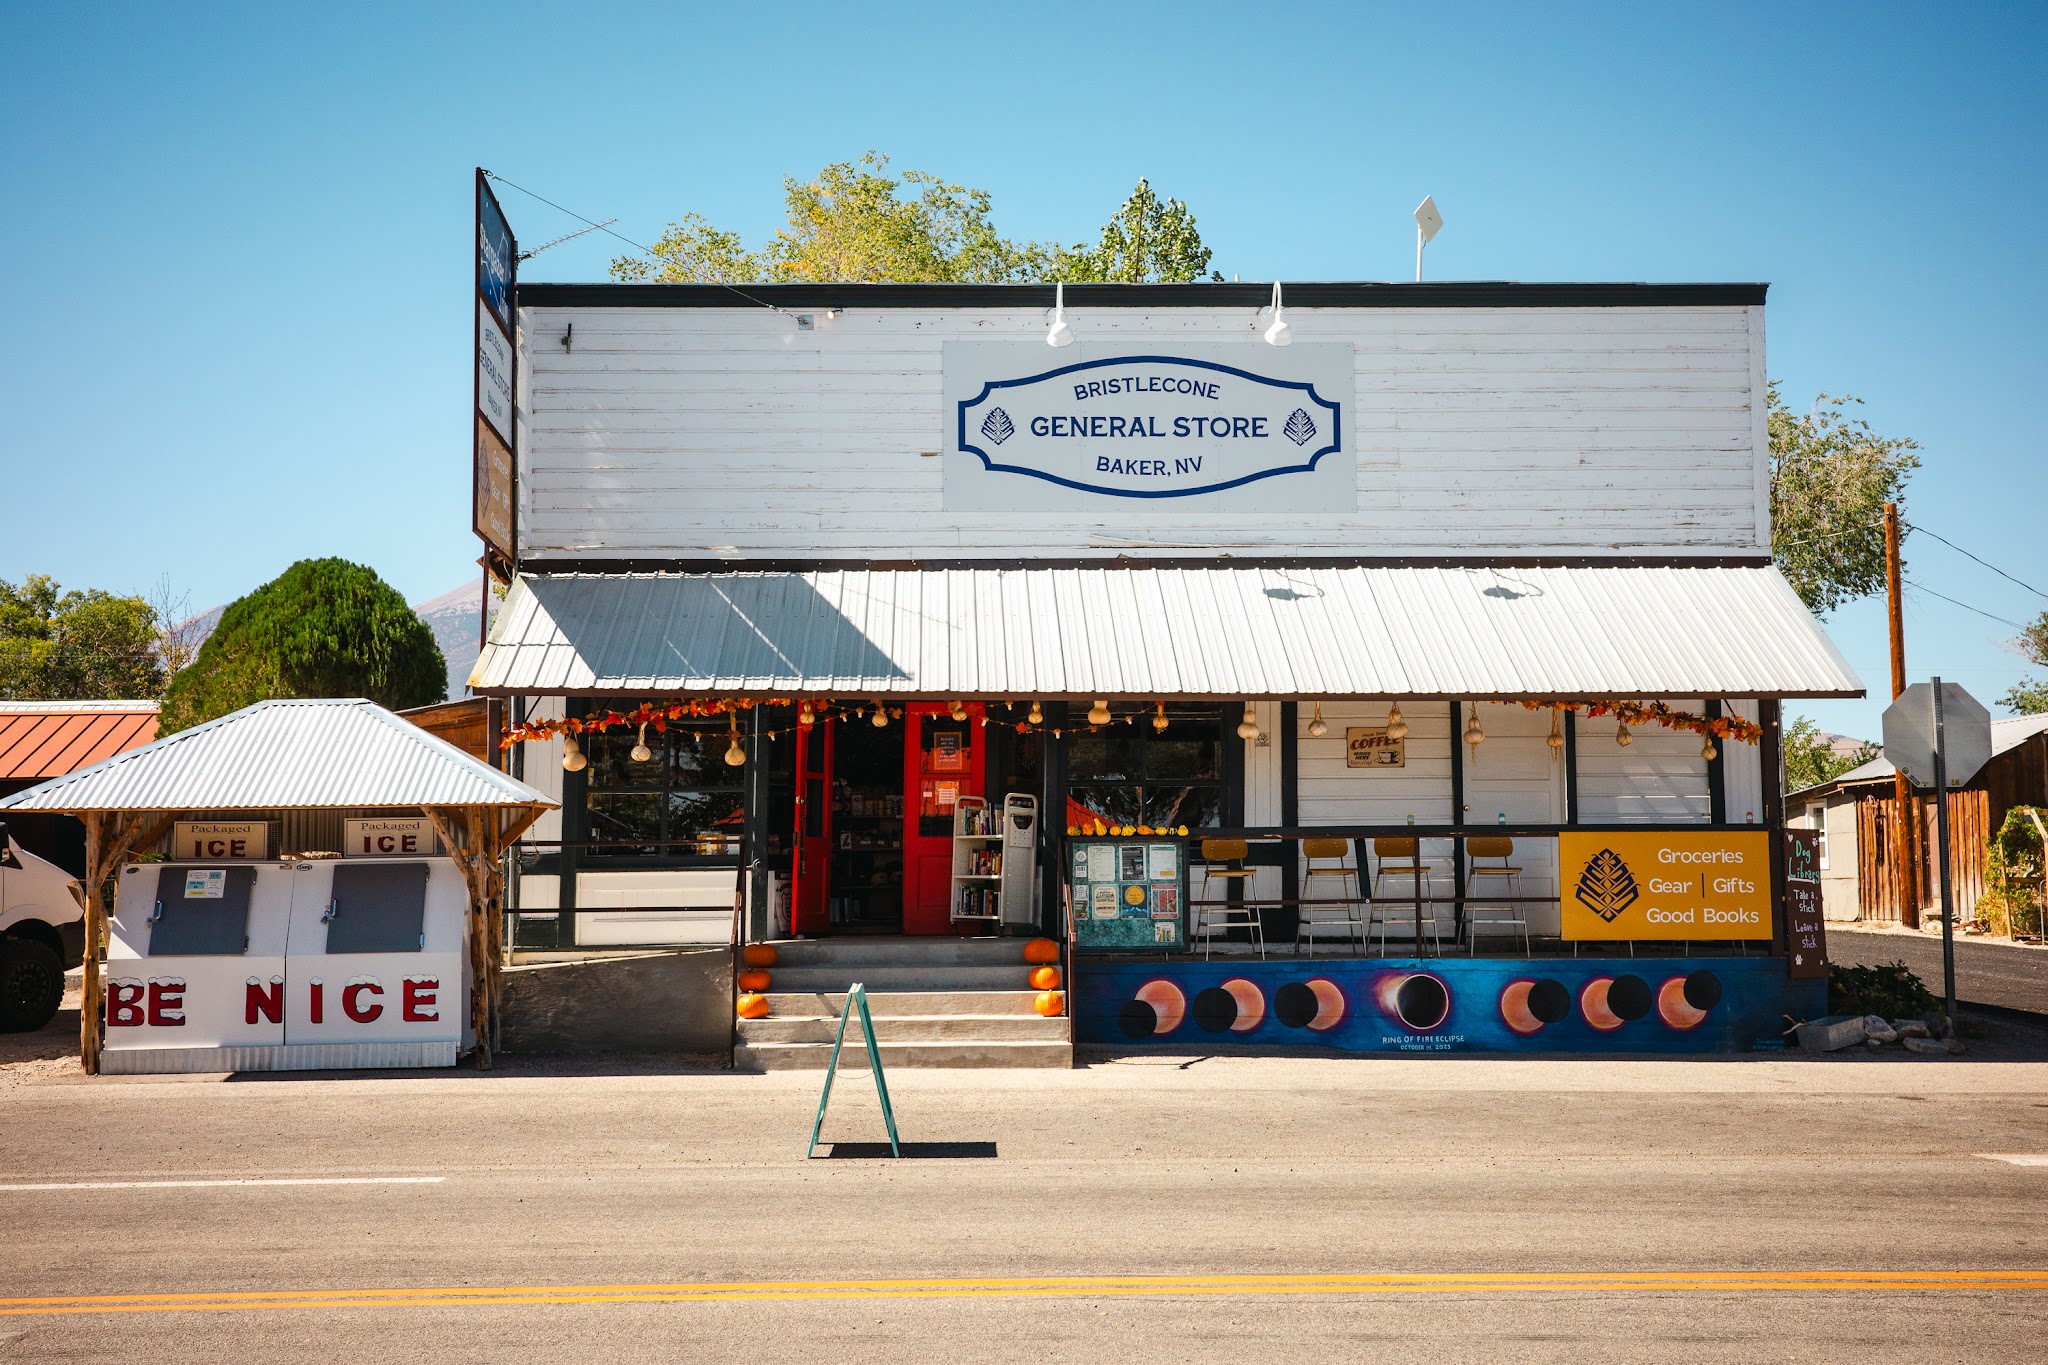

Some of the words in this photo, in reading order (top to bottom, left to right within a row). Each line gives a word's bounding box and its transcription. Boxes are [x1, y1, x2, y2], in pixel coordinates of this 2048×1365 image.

[1074, 377, 1220, 400] BRISTLECONE
[1030, 416, 1166, 437] GENERAL
[1173, 417, 1269, 438] STORE
[1096, 456, 1172, 477] BAKER,
[1175, 456, 1203, 474] NV
[1350, 735, 1400, 750] COFFEE
[191, 825, 250, 833] Packaged
[361, 822, 420, 831] Packaged
[194, 838, 246, 857] ICE
[363, 834, 417, 852] ICE
[1658, 849, 1743, 864] Groceries
[1796, 840, 1810, 864] Dog
[1789, 857, 1820, 884] Library
[1649, 878, 1692, 893] Gear
[1713, 878, 1755, 893] Gifts
[1794, 890, 1808, 900] Take
[1811, 891, 1814, 899] a
[1799, 901, 1815, 912] stick
[1647, 908, 1694, 923] Good
[1704, 908, 1759, 923] Books
[1795, 920, 1813, 932] Leave
[1814, 923, 1818, 931] a
[1802, 935, 1817, 948] stick
[107, 976, 186, 1026] BE
[245, 974, 439, 1024] NICE
